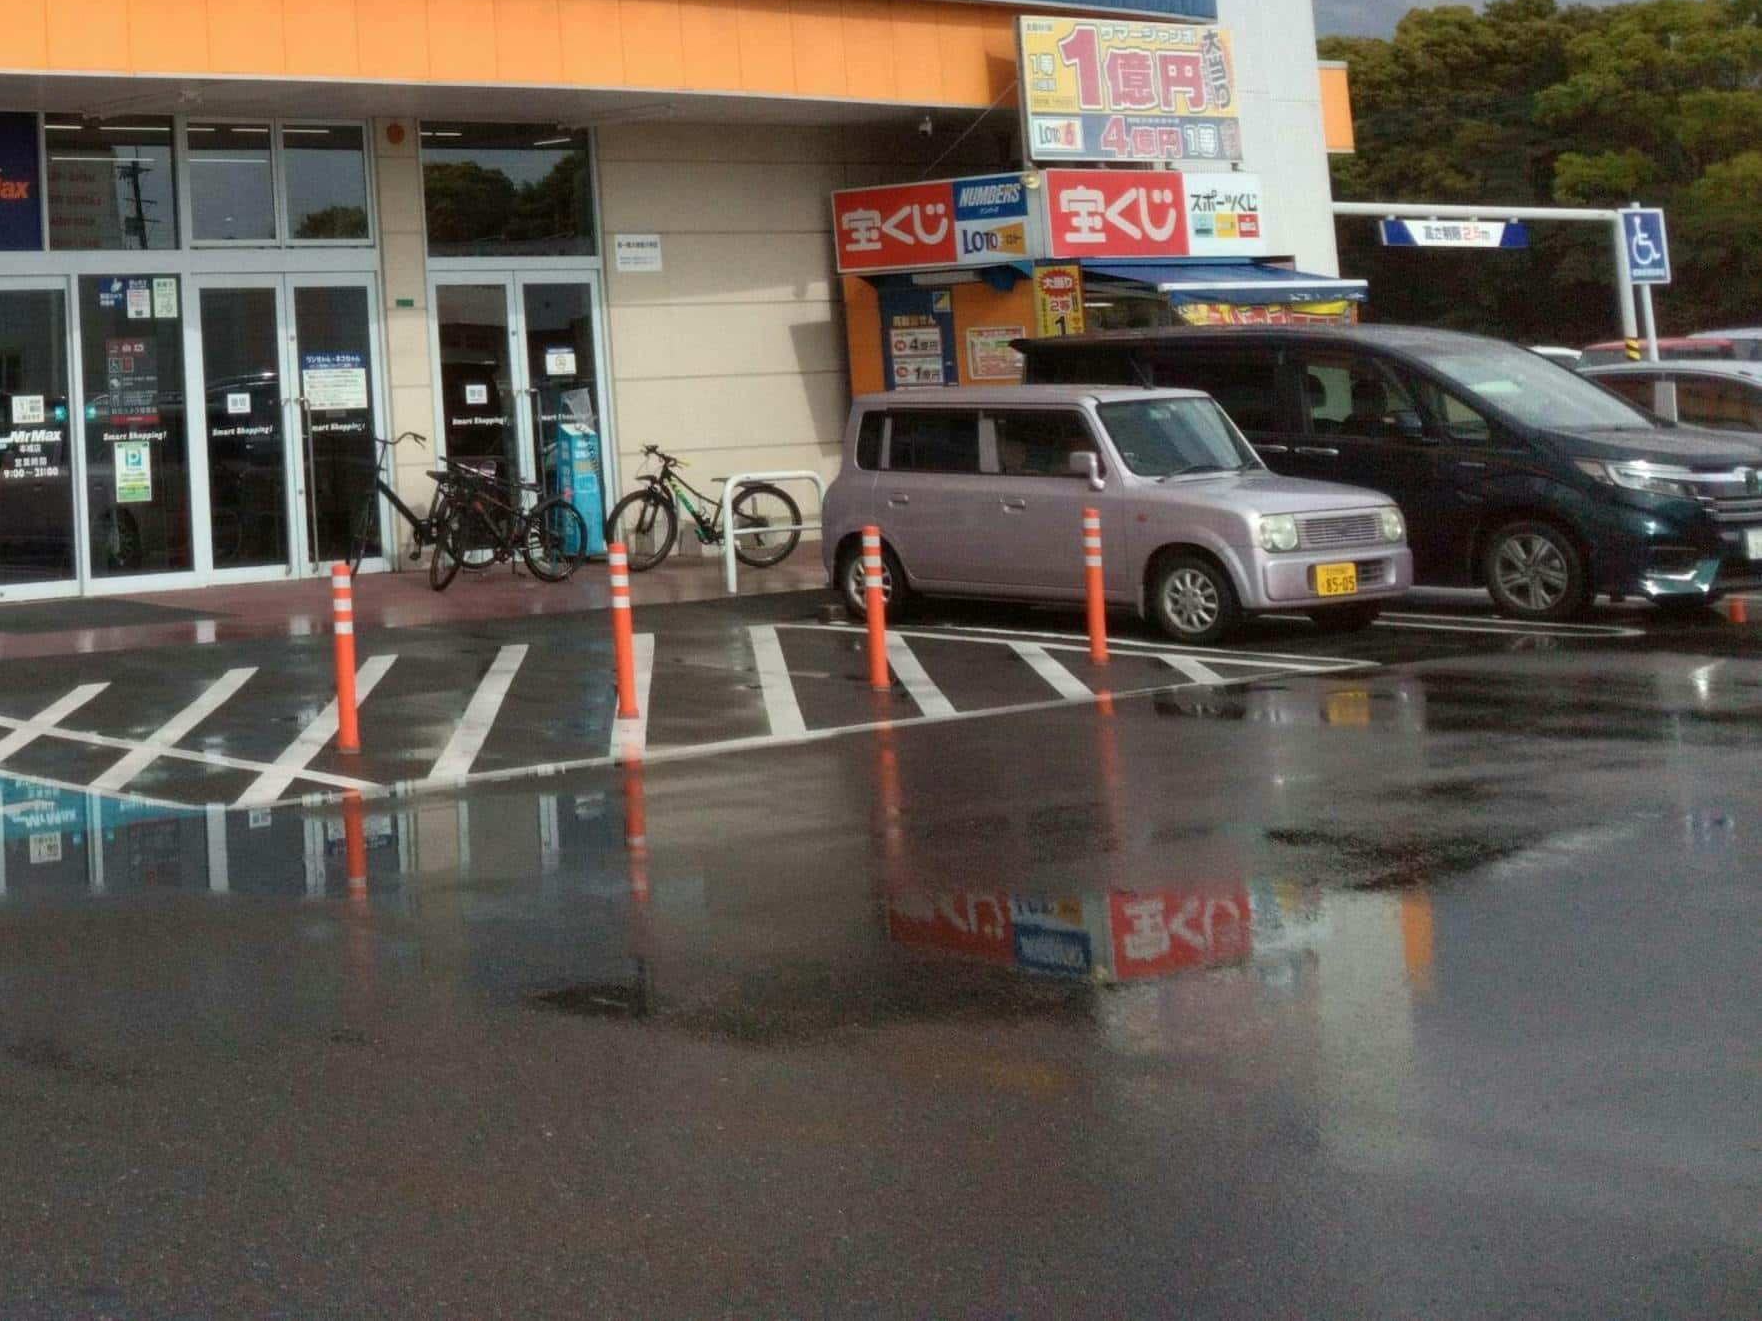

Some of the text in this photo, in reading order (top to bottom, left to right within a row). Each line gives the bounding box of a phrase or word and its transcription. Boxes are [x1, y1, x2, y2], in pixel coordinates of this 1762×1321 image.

[958, 182, 1022, 207] NUMBERS
[1190, 189, 1258, 212] スポーツくじ
[1059, 185, 1177, 243] 宝くじ
[842, 203, 949, 252] 宝くじ
[963, 229, 998, 255] LOTO
